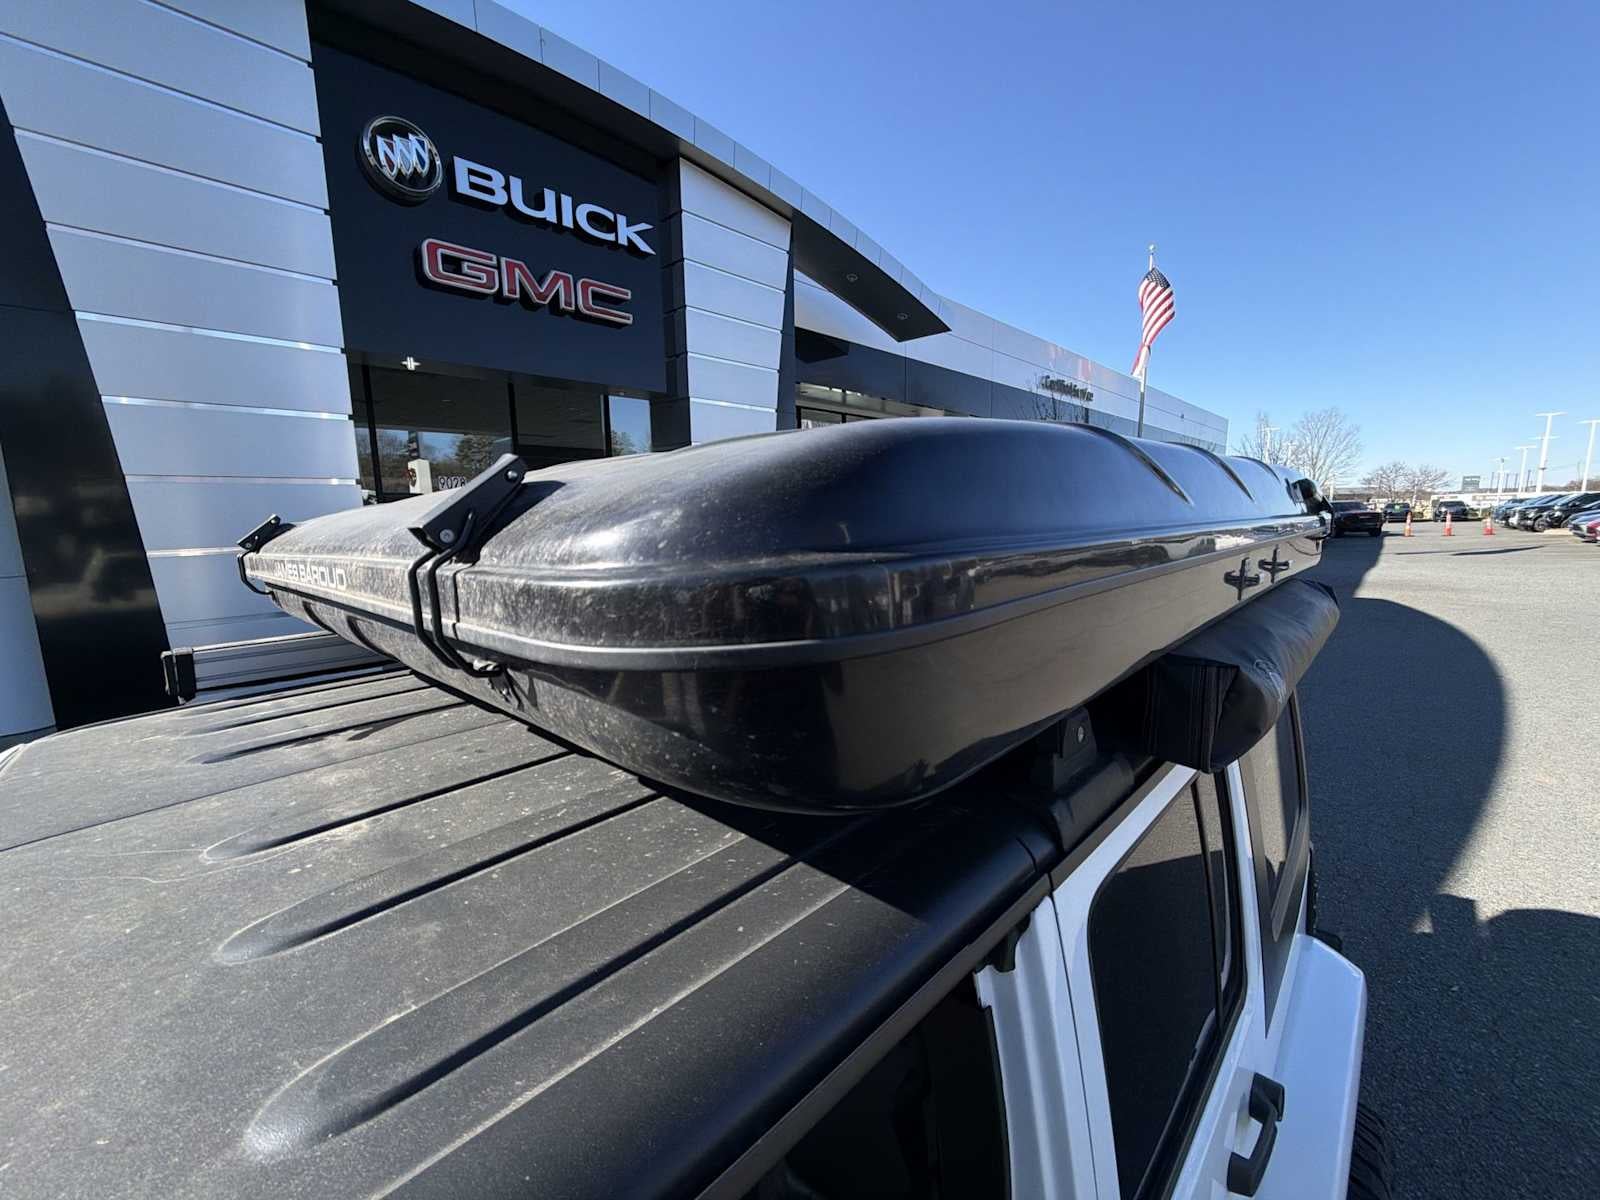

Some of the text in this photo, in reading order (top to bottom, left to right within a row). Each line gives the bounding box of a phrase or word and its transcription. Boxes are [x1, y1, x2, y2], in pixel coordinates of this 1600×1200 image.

[453, 155, 656, 255] BUICK
[421, 238, 633, 324] GMC
[299, 564, 347, 591] BAROUD
